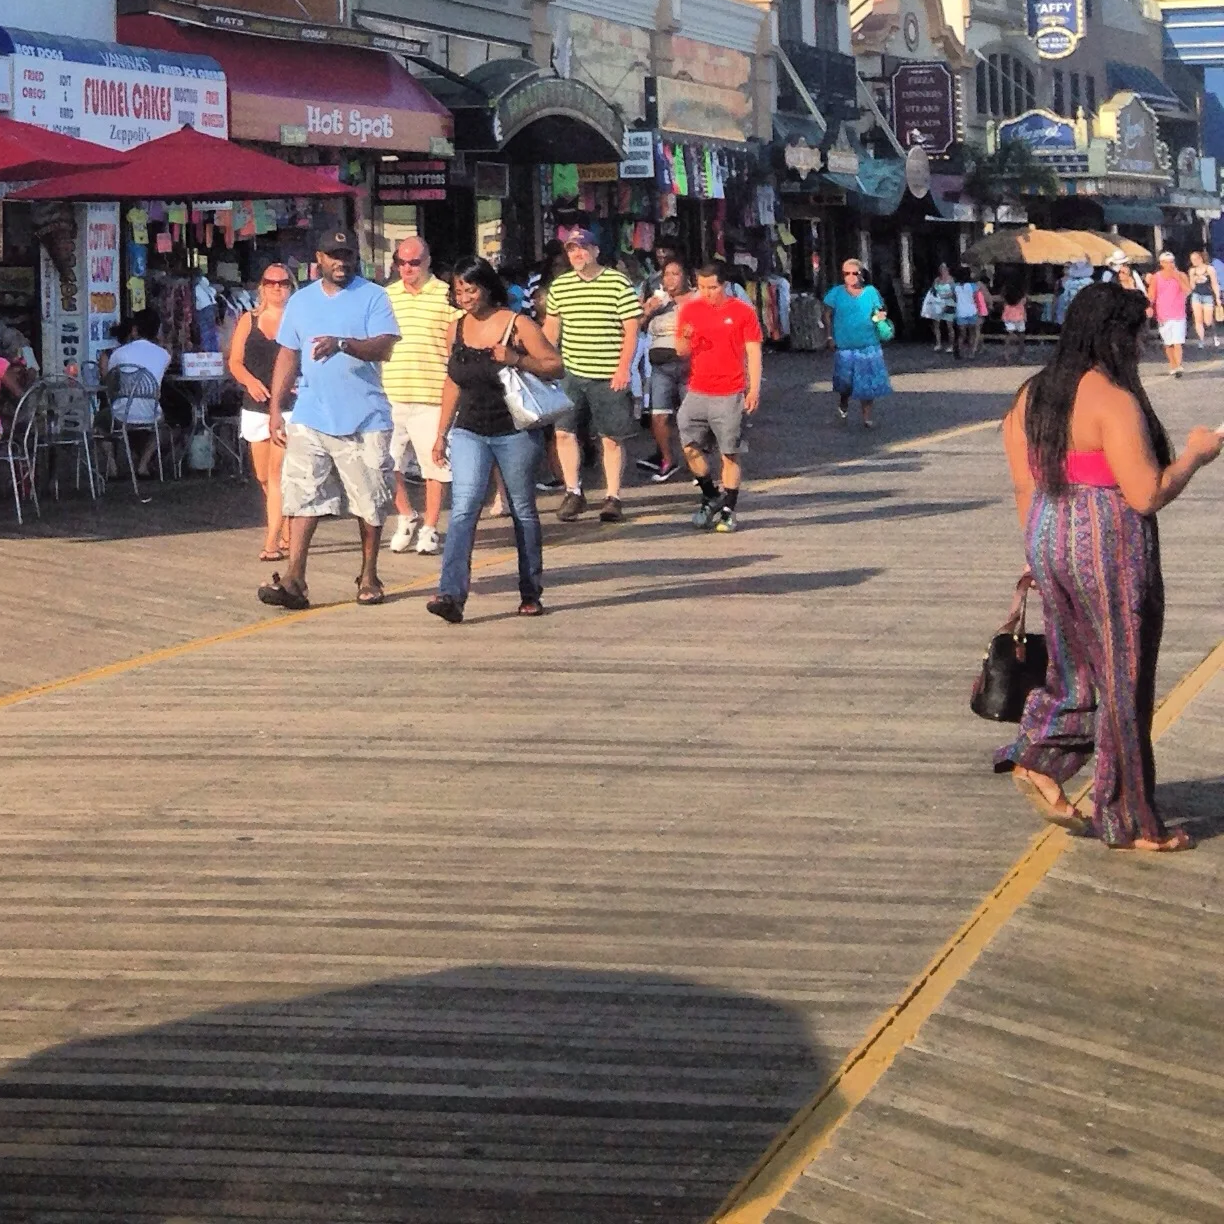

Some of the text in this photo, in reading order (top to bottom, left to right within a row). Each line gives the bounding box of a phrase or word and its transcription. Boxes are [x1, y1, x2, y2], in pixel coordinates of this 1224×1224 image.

[1033, 2, 1073, 14] TAFFY
[215, 15, 244, 27] HATS
[15, 44, 63, 61] HOT DOGS
[23, 69, 44, 82] FRIED
[23, 87, 46, 100] OREOS
[84, 77, 172, 122] FUNNEL CAKES
[306, 105, 394, 143] Hot Spot
